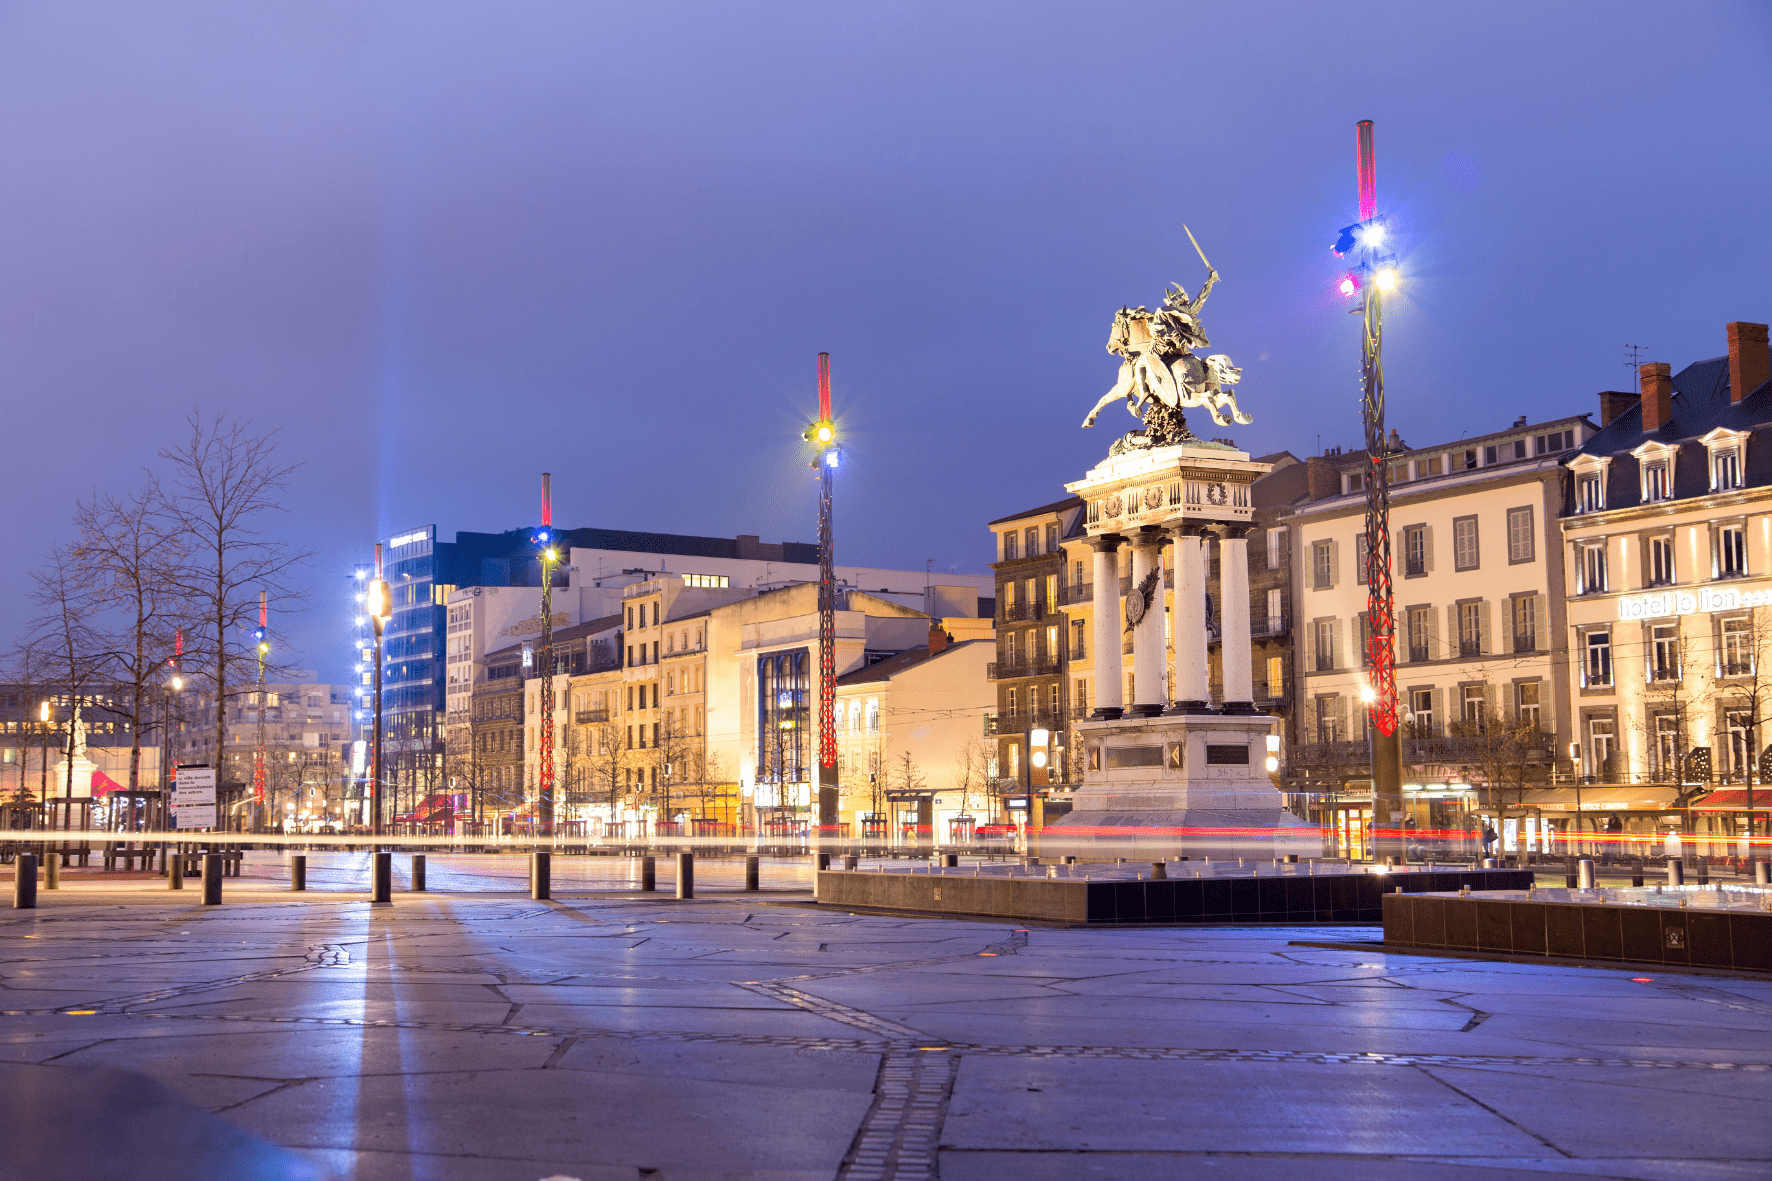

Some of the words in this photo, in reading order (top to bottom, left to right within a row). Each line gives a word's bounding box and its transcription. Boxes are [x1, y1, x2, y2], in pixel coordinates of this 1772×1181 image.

[1619, 593, 1668, 618] hotel
[1674, 592, 1693, 613] le
[1699, 588, 1737, 611] lion
